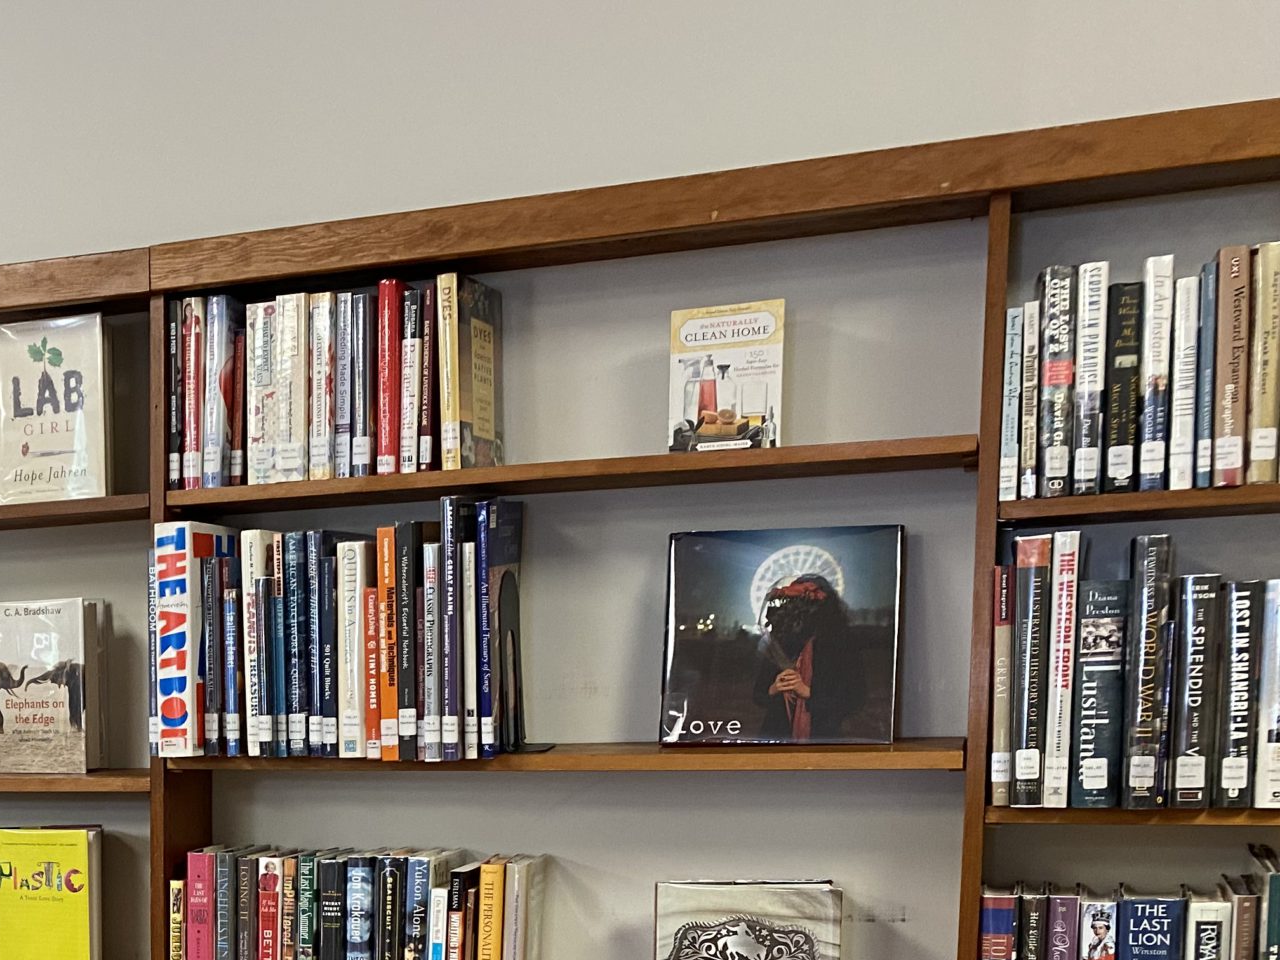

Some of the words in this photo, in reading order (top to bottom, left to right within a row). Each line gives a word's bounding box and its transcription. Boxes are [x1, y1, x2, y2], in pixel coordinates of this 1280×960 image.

[441, 285, 452, 321] DYES
[1232, 284, 1246, 341] Westward
[472, 324, 493, 343] DYES
[708, 317, 760, 329] NATURALLY
[684, 330, 728, 343] CLEAN
[730, 325, 770, 338] HOME
[339, 359, 348, 391] Made
[1230, 343, 1246, 405] Expansion
[11, 369, 87, 421] LAB
[339, 393, 348, 420] Simple
[23, 422, 75, 437] GIRL
[13, 467, 43, 485] Hope
[47, 466, 88, 483] Jahren
[157, 527, 187, 600] THE
[1088, 590, 1118, 602] Diana
[3, 608, 12, 617] C.
[14, 607, 22, 616] A.
[23, 606, 61, 617] Bradshaw
[1085, 604, 1120, 615] Preston
[1234, 590, 1251, 630] LOST
[158, 610, 189, 672] ART
[1233, 632, 1250, 655] IN
[5, 698, 50, 712] Elephants
[52, 701, 64, 709] on
[1230, 656, 1251, 741] SHANGRI-LA
[15, 714, 30, 724] the
[32, 714, 55, 726] Edge
[159, 675, 189, 753] BOO
[415, 863, 429, 901] Yukon
[413, 903, 427, 938] Alone
[1134, 904, 1168, 918] THE
[1129, 918, 1172, 932] LAST
[1129, 932, 1171, 947] LION
[1131, 946, 1168, 956] Winston
